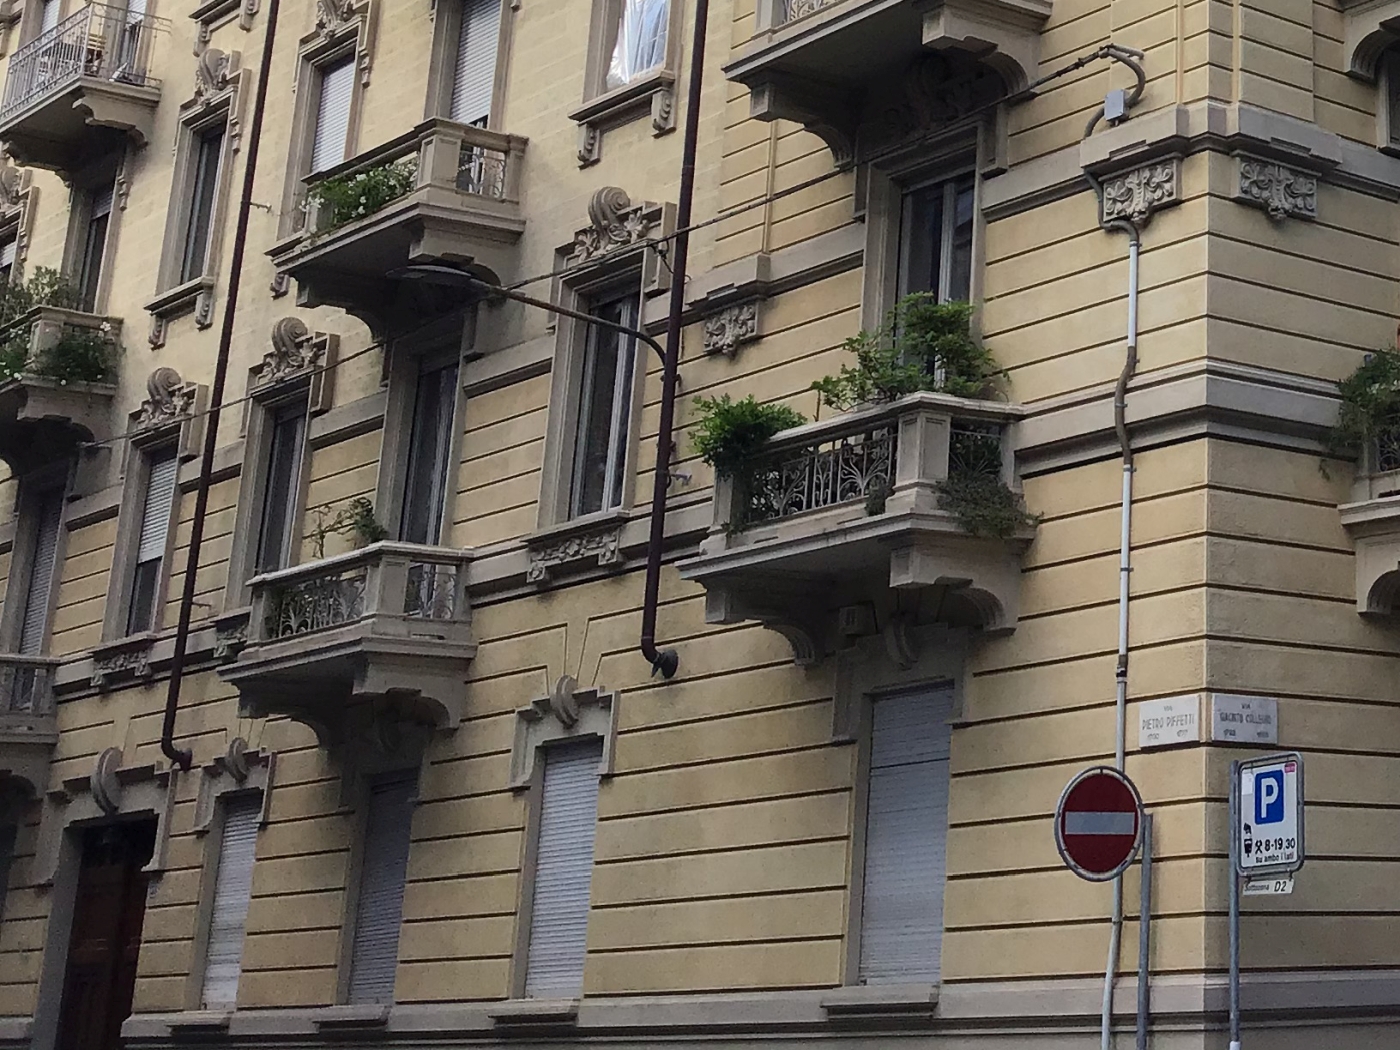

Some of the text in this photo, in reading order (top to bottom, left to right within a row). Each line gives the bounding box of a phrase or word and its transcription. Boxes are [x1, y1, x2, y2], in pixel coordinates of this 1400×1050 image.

[1261, 777, 1279, 819] P
[1264, 853, 1280, 862] ambo
[1274, 880, 1287, 892] D2
